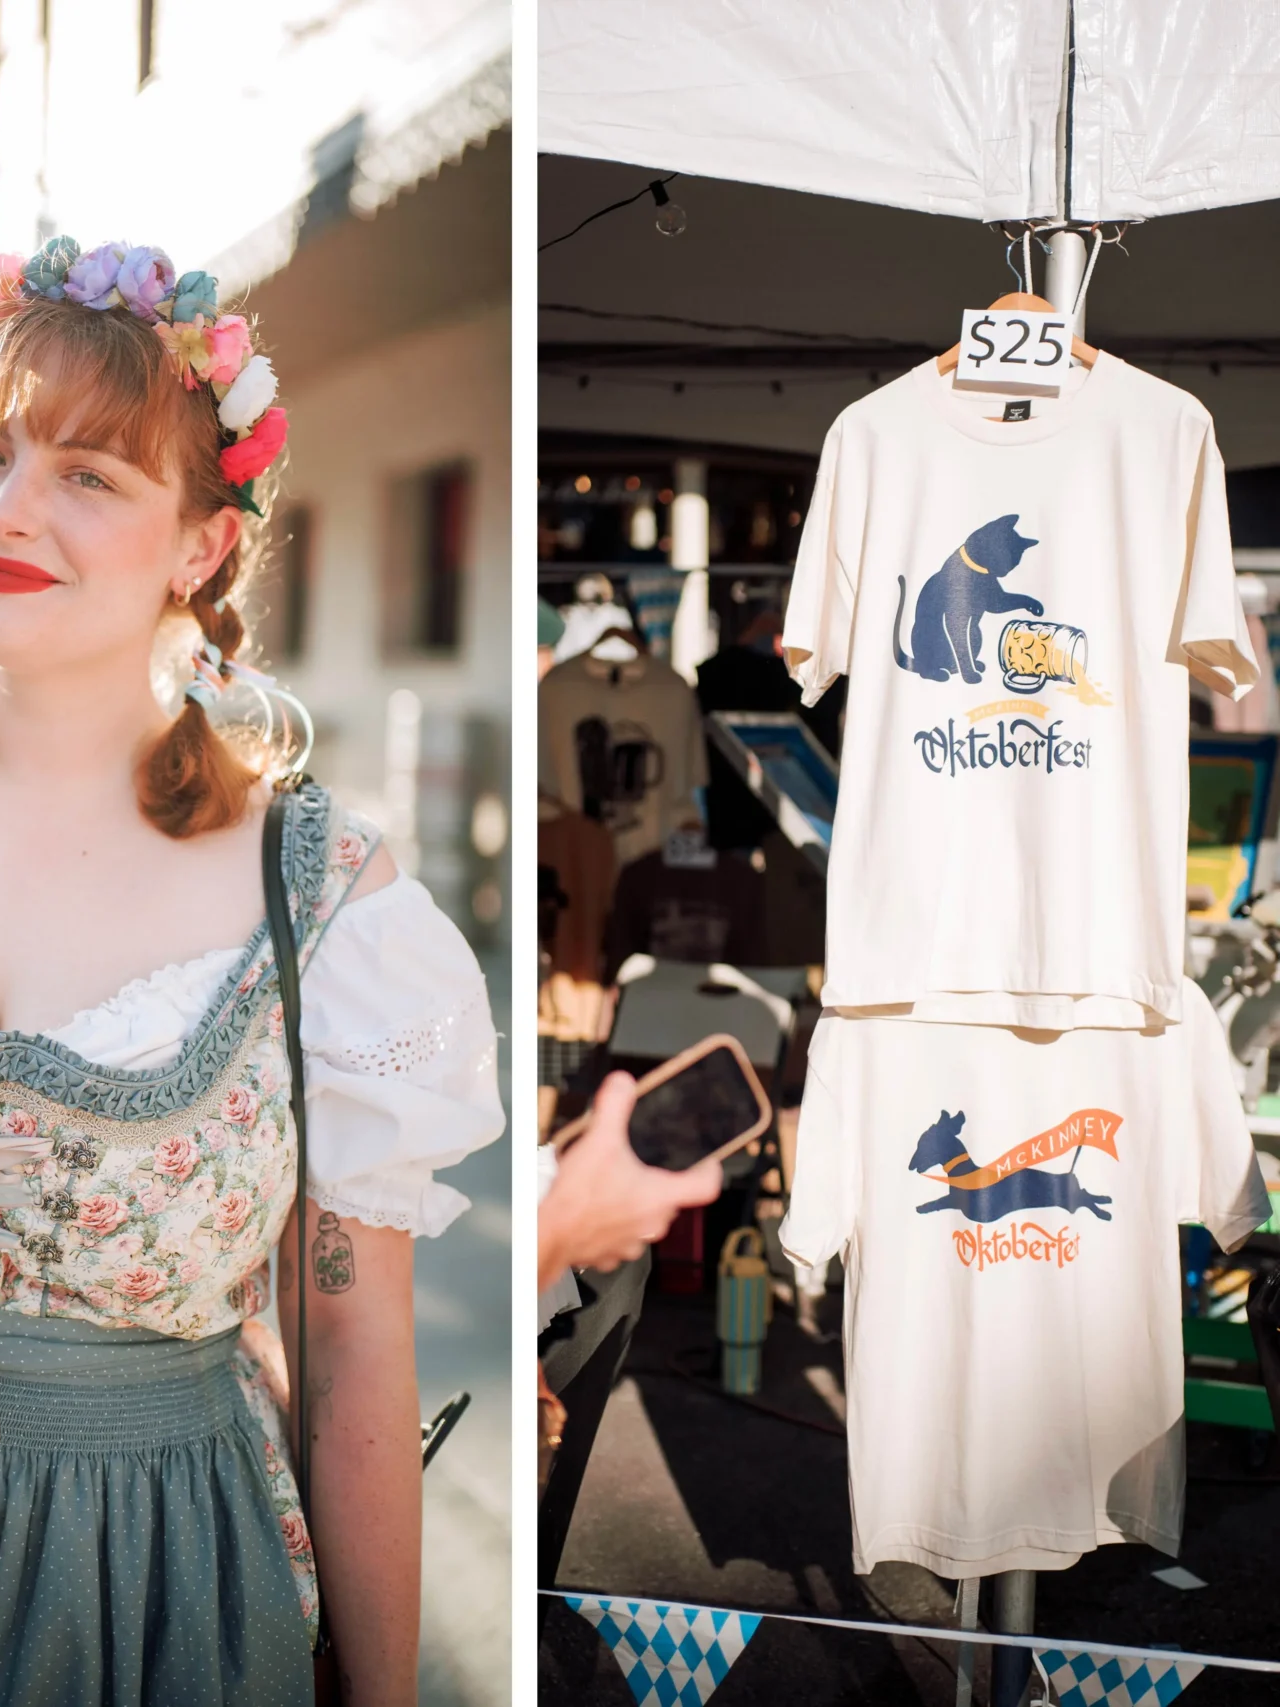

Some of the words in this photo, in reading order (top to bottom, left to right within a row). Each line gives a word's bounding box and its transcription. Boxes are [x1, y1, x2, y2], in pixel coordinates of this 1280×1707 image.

[967, 315, 1065, 368] $25
[914, 717, 1092, 778] Oktoberfest
[952, 1222, 1080, 1272] Oktoberfet
